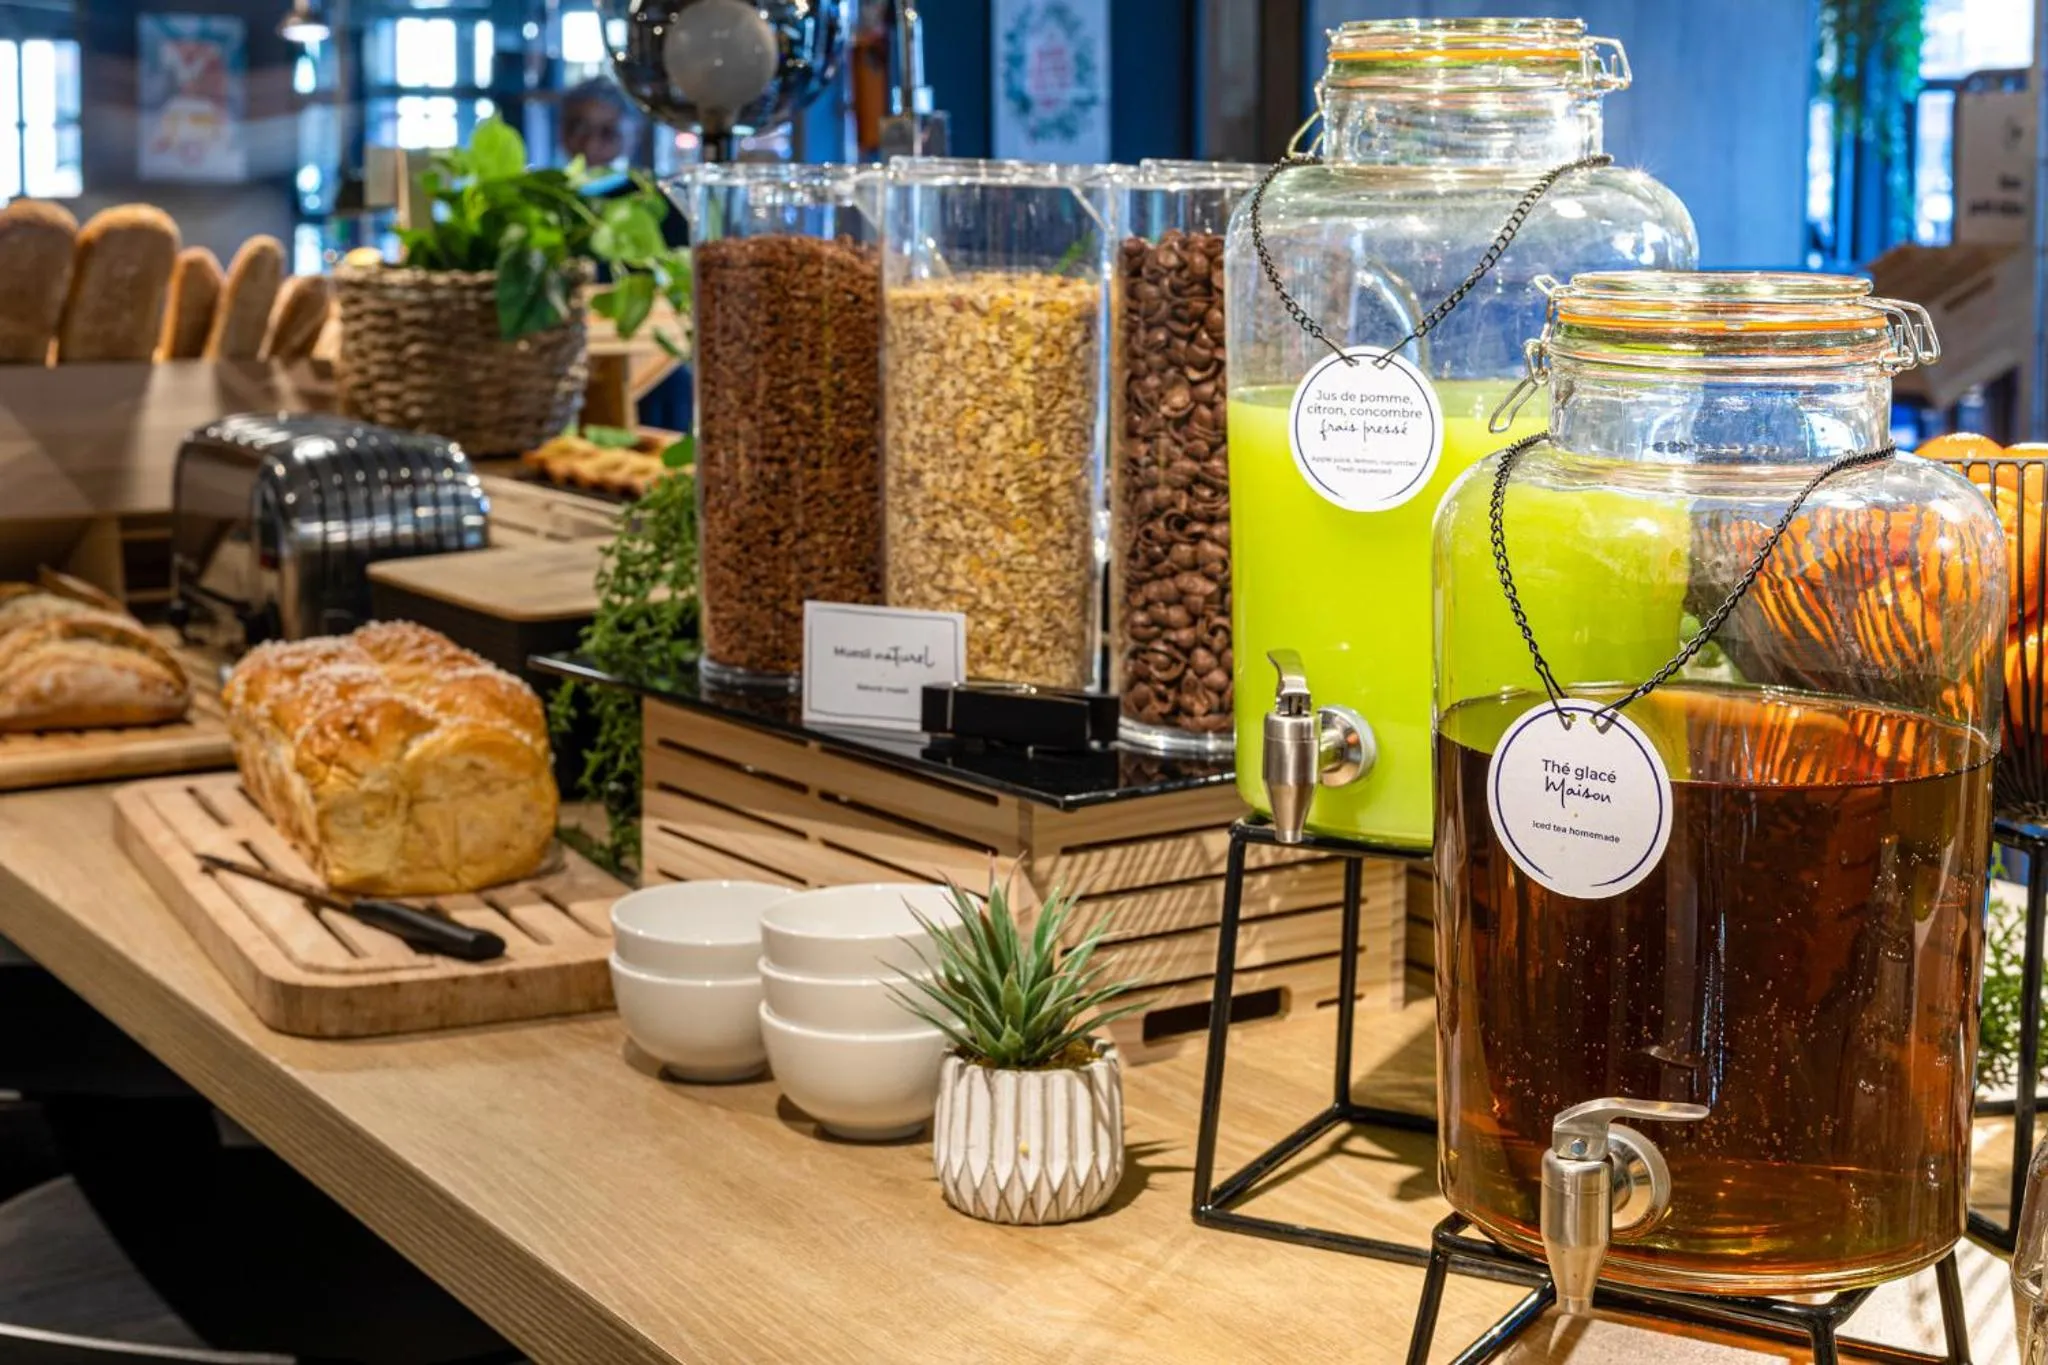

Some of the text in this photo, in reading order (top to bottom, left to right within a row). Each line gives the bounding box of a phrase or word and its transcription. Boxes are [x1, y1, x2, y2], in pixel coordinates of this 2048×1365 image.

[1316, 390, 1413, 405] Jus de pomme,
[1307, 403, 1422, 419] citron, concombre
[1320, 419, 1408, 442] frais pressé
[874, 645, 936, 669] naturel
[1542, 759, 1617, 783] Thé glacé
[1545, 776, 1611, 809] Maison
[1532, 820, 1620, 843] Iced tea homemade
